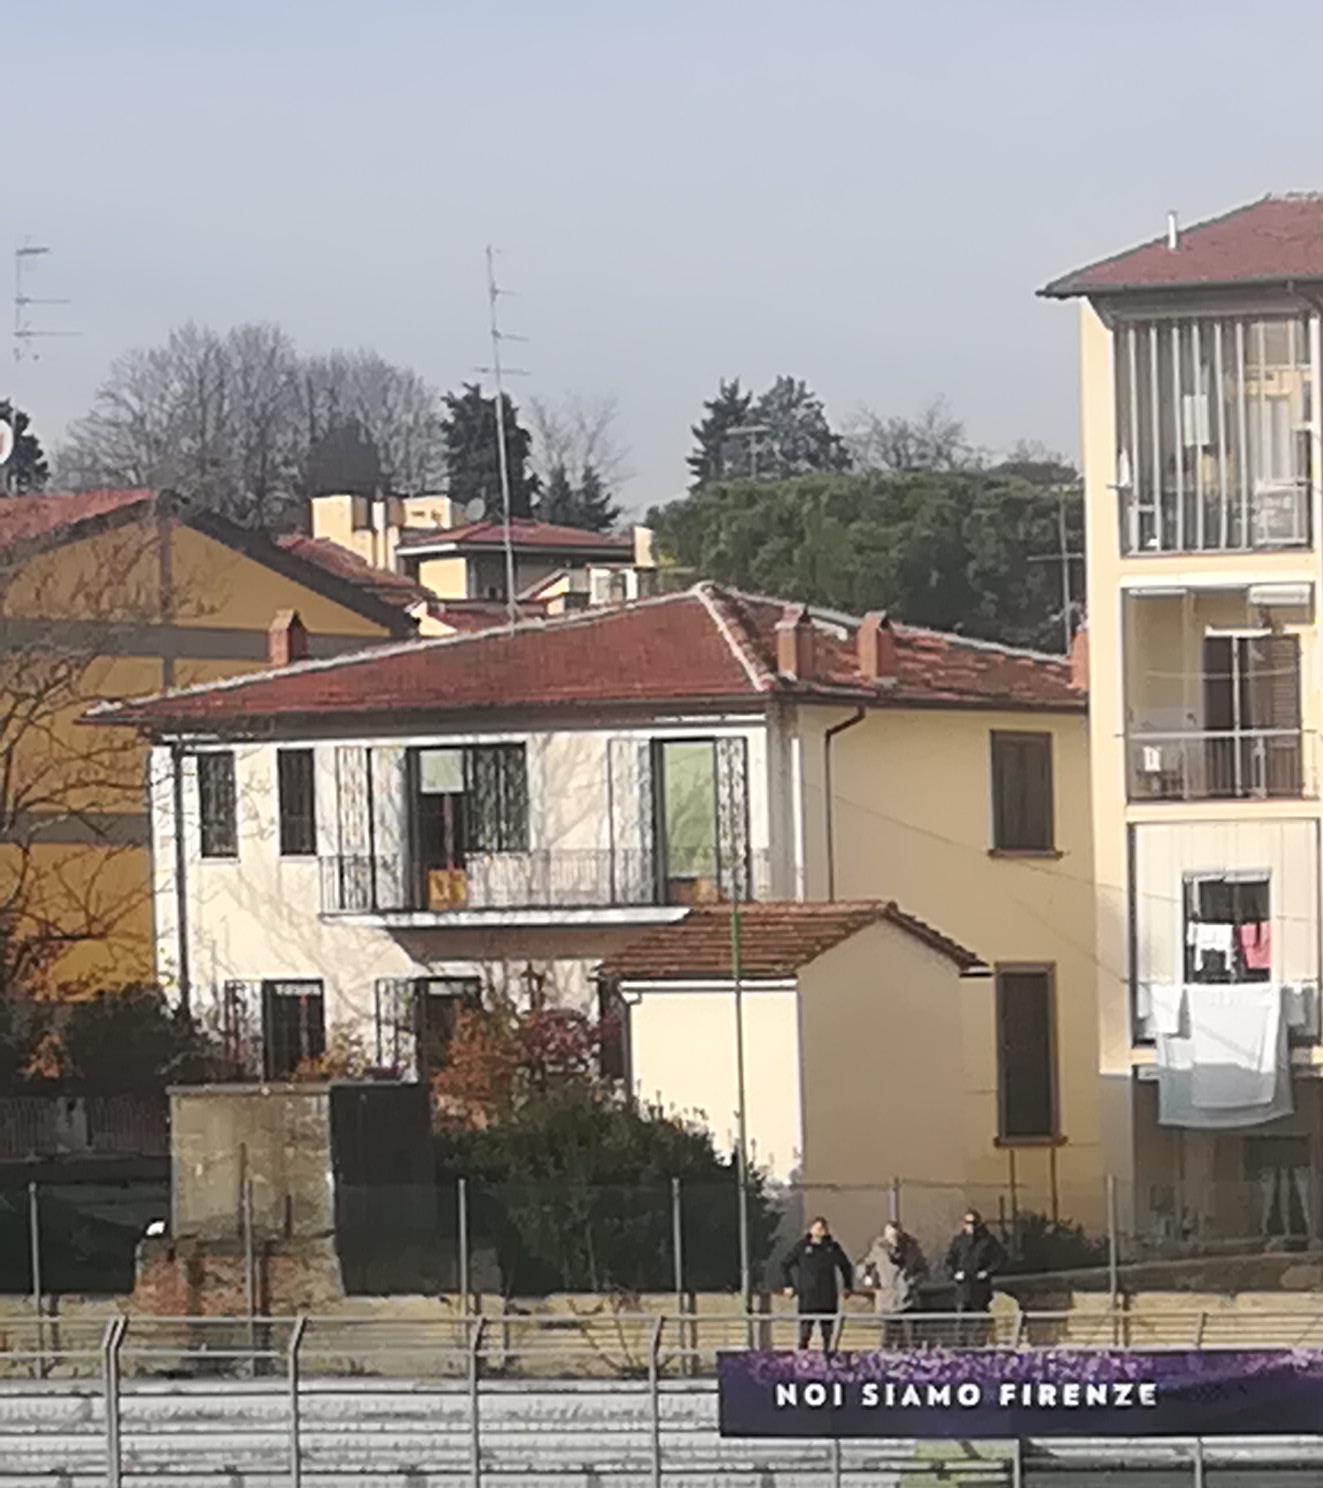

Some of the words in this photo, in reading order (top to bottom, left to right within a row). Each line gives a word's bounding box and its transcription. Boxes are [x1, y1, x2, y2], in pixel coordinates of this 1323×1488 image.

[775, 1383, 842, 1407] NOI
[861, 1383, 981, 1406] SIAMO
[999, 1383, 1157, 1406] FIRENZE
